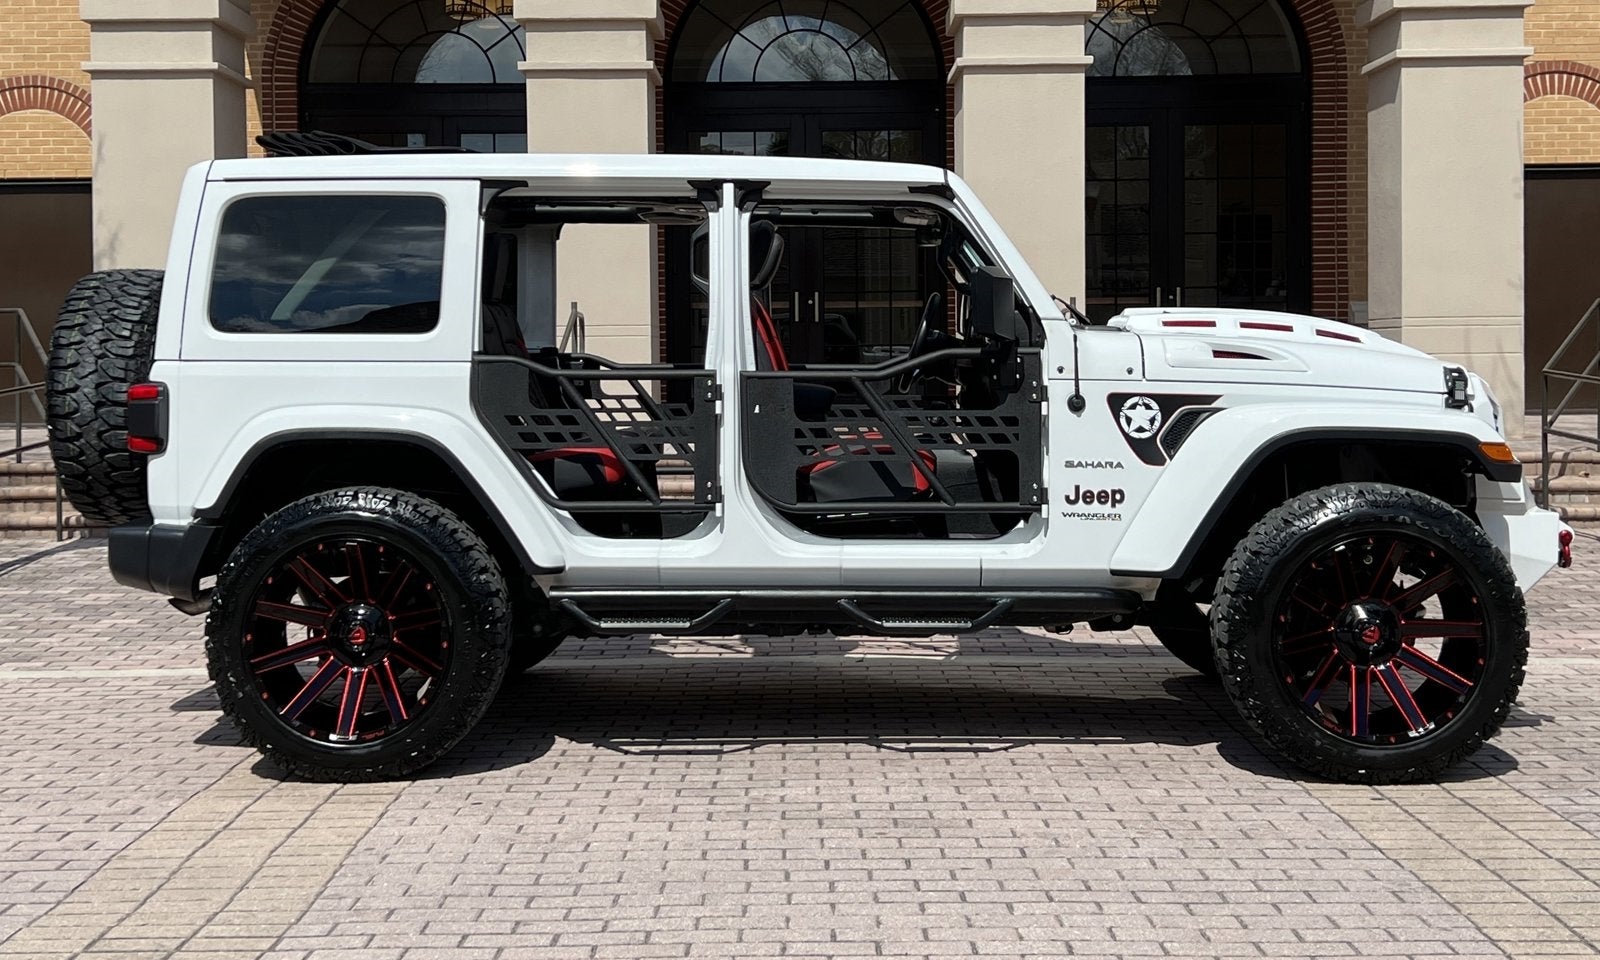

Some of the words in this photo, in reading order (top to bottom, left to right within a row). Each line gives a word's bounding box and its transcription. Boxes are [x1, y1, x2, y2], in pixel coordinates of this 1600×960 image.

[1064, 460, 1125, 470] SAHARA
[1064, 484, 1125, 509] Jeep
[1061, 511, 1122, 519] WRANGLER
